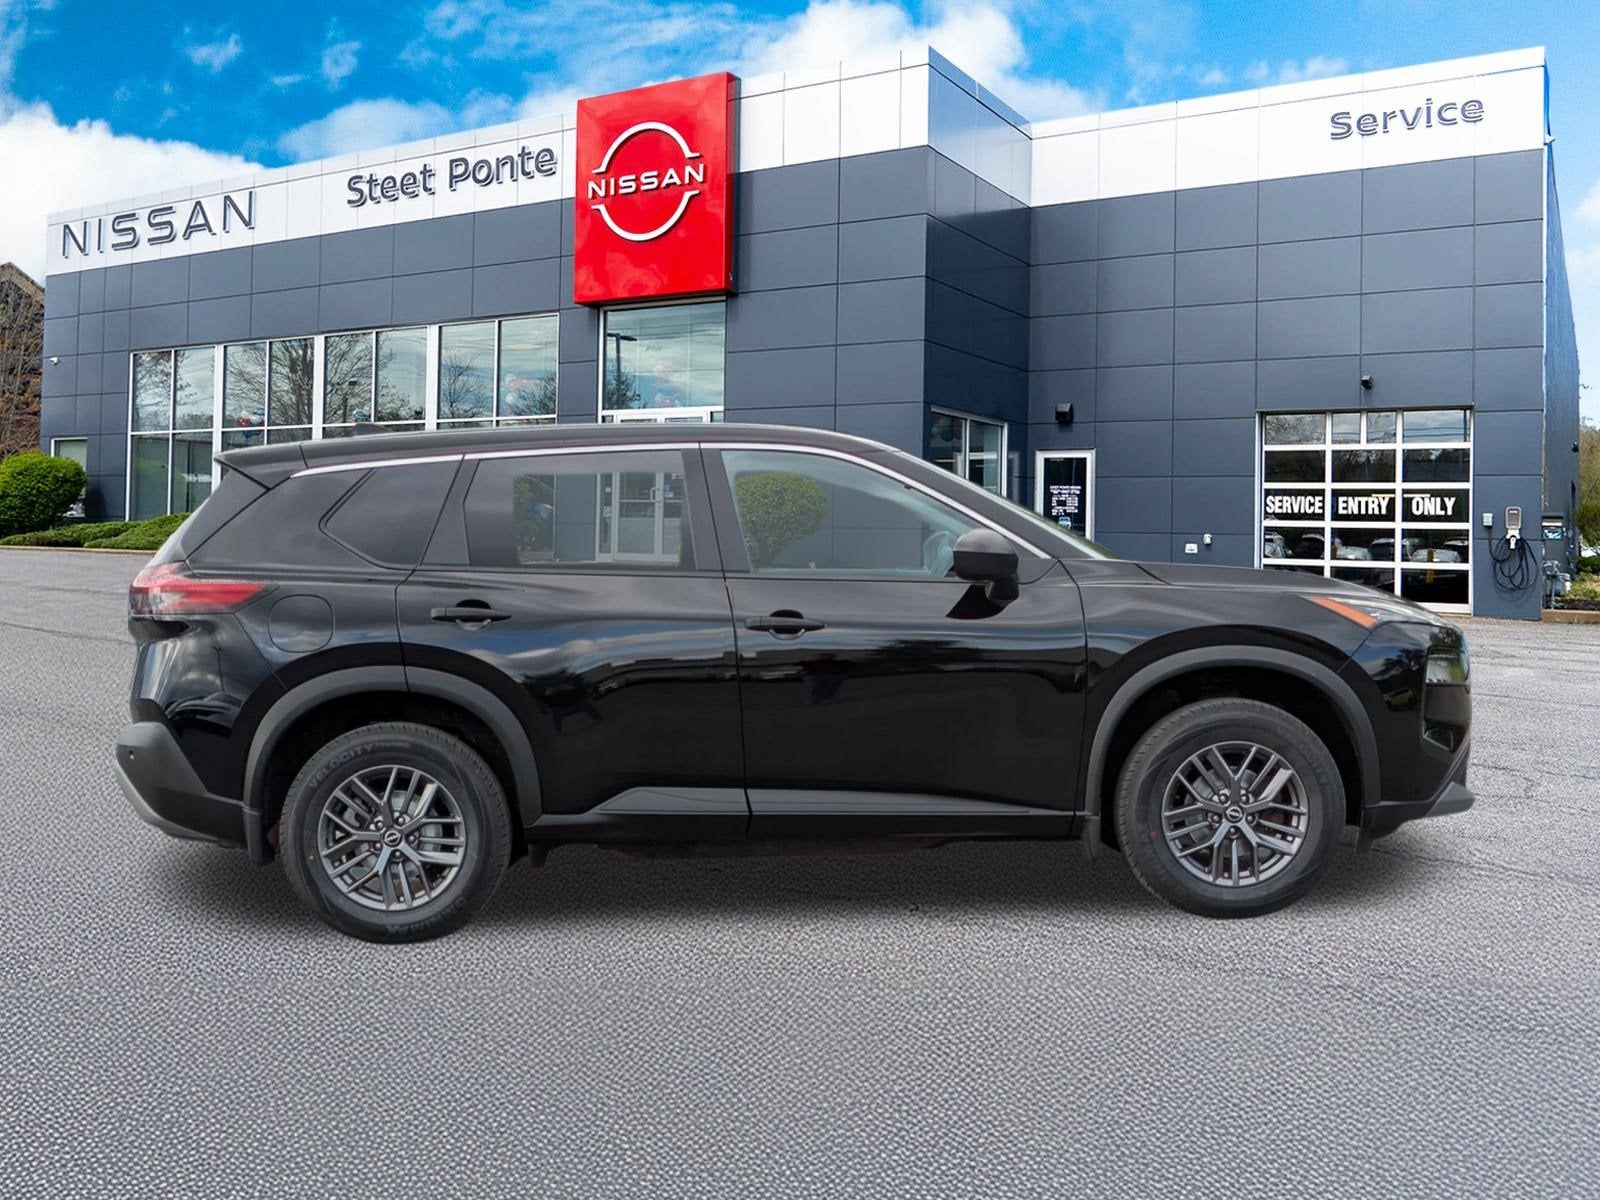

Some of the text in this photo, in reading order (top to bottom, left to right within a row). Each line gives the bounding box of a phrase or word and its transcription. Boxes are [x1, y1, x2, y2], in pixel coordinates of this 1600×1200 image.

[1330, 98, 1485, 140] Service
[346, 146, 558, 207] Steet Ponte
[587, 163, 704, 199] NISSAN
[62, 191, 256, 259] NISSAN
[1265, 495, 1456, 516] SERVICE ENTRY ONLY
[308, 743, 373, 788] VELOCITY
